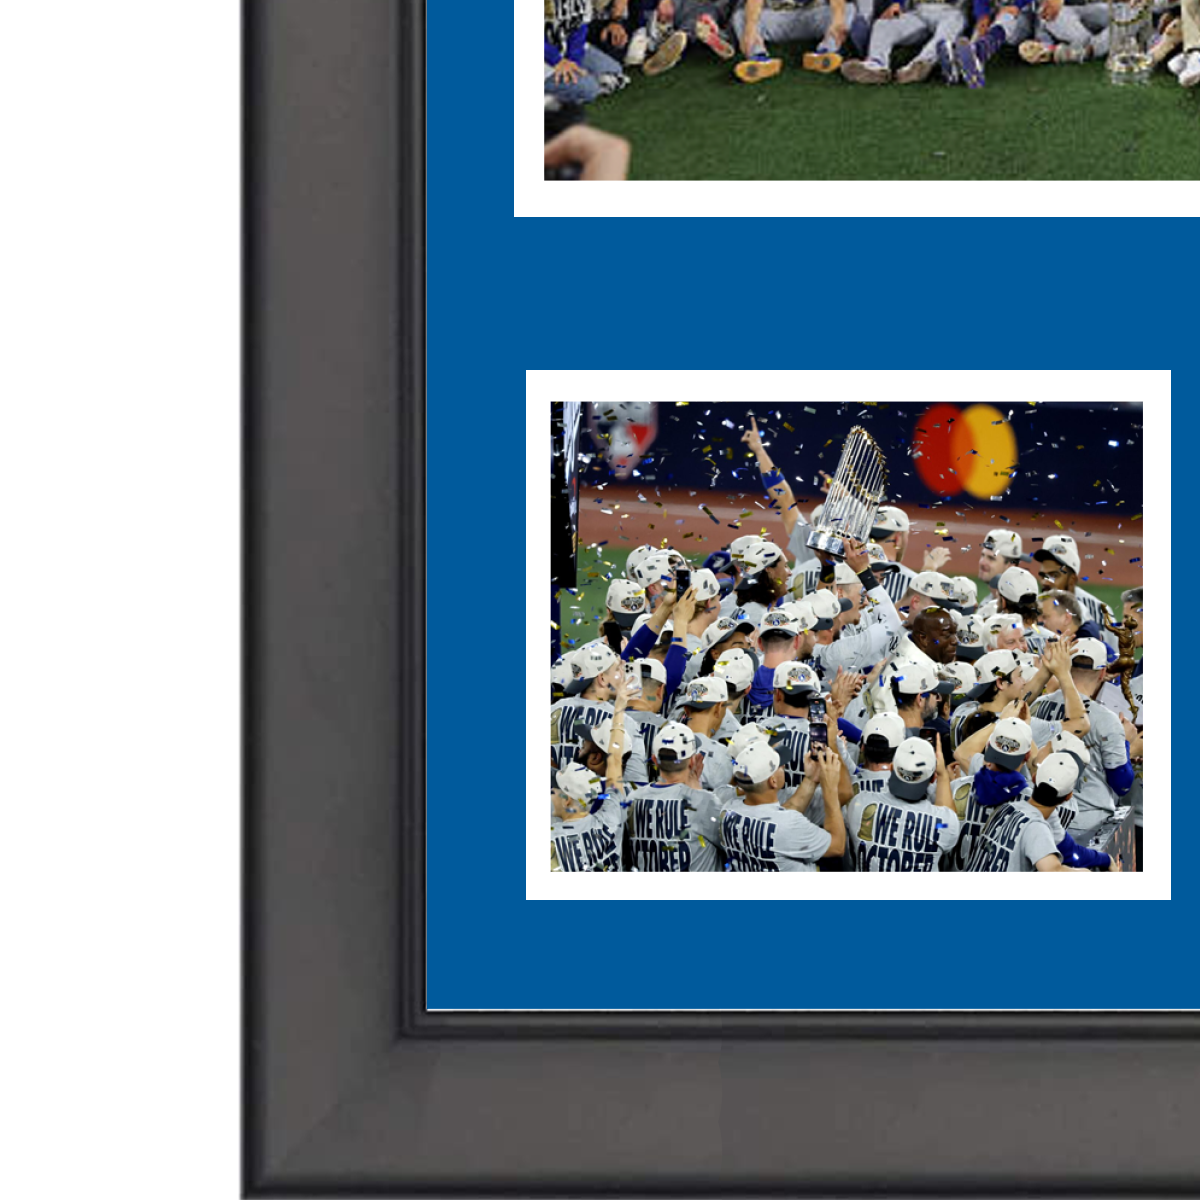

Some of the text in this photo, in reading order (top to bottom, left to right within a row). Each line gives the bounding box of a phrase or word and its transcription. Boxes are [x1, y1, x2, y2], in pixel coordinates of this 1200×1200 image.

[634, 799, 692, 841] WE RULE
[742, 816, 777, 859] RULE
[874, 802, 903, 848] WE
[901, 810, 943, 853] RULE
